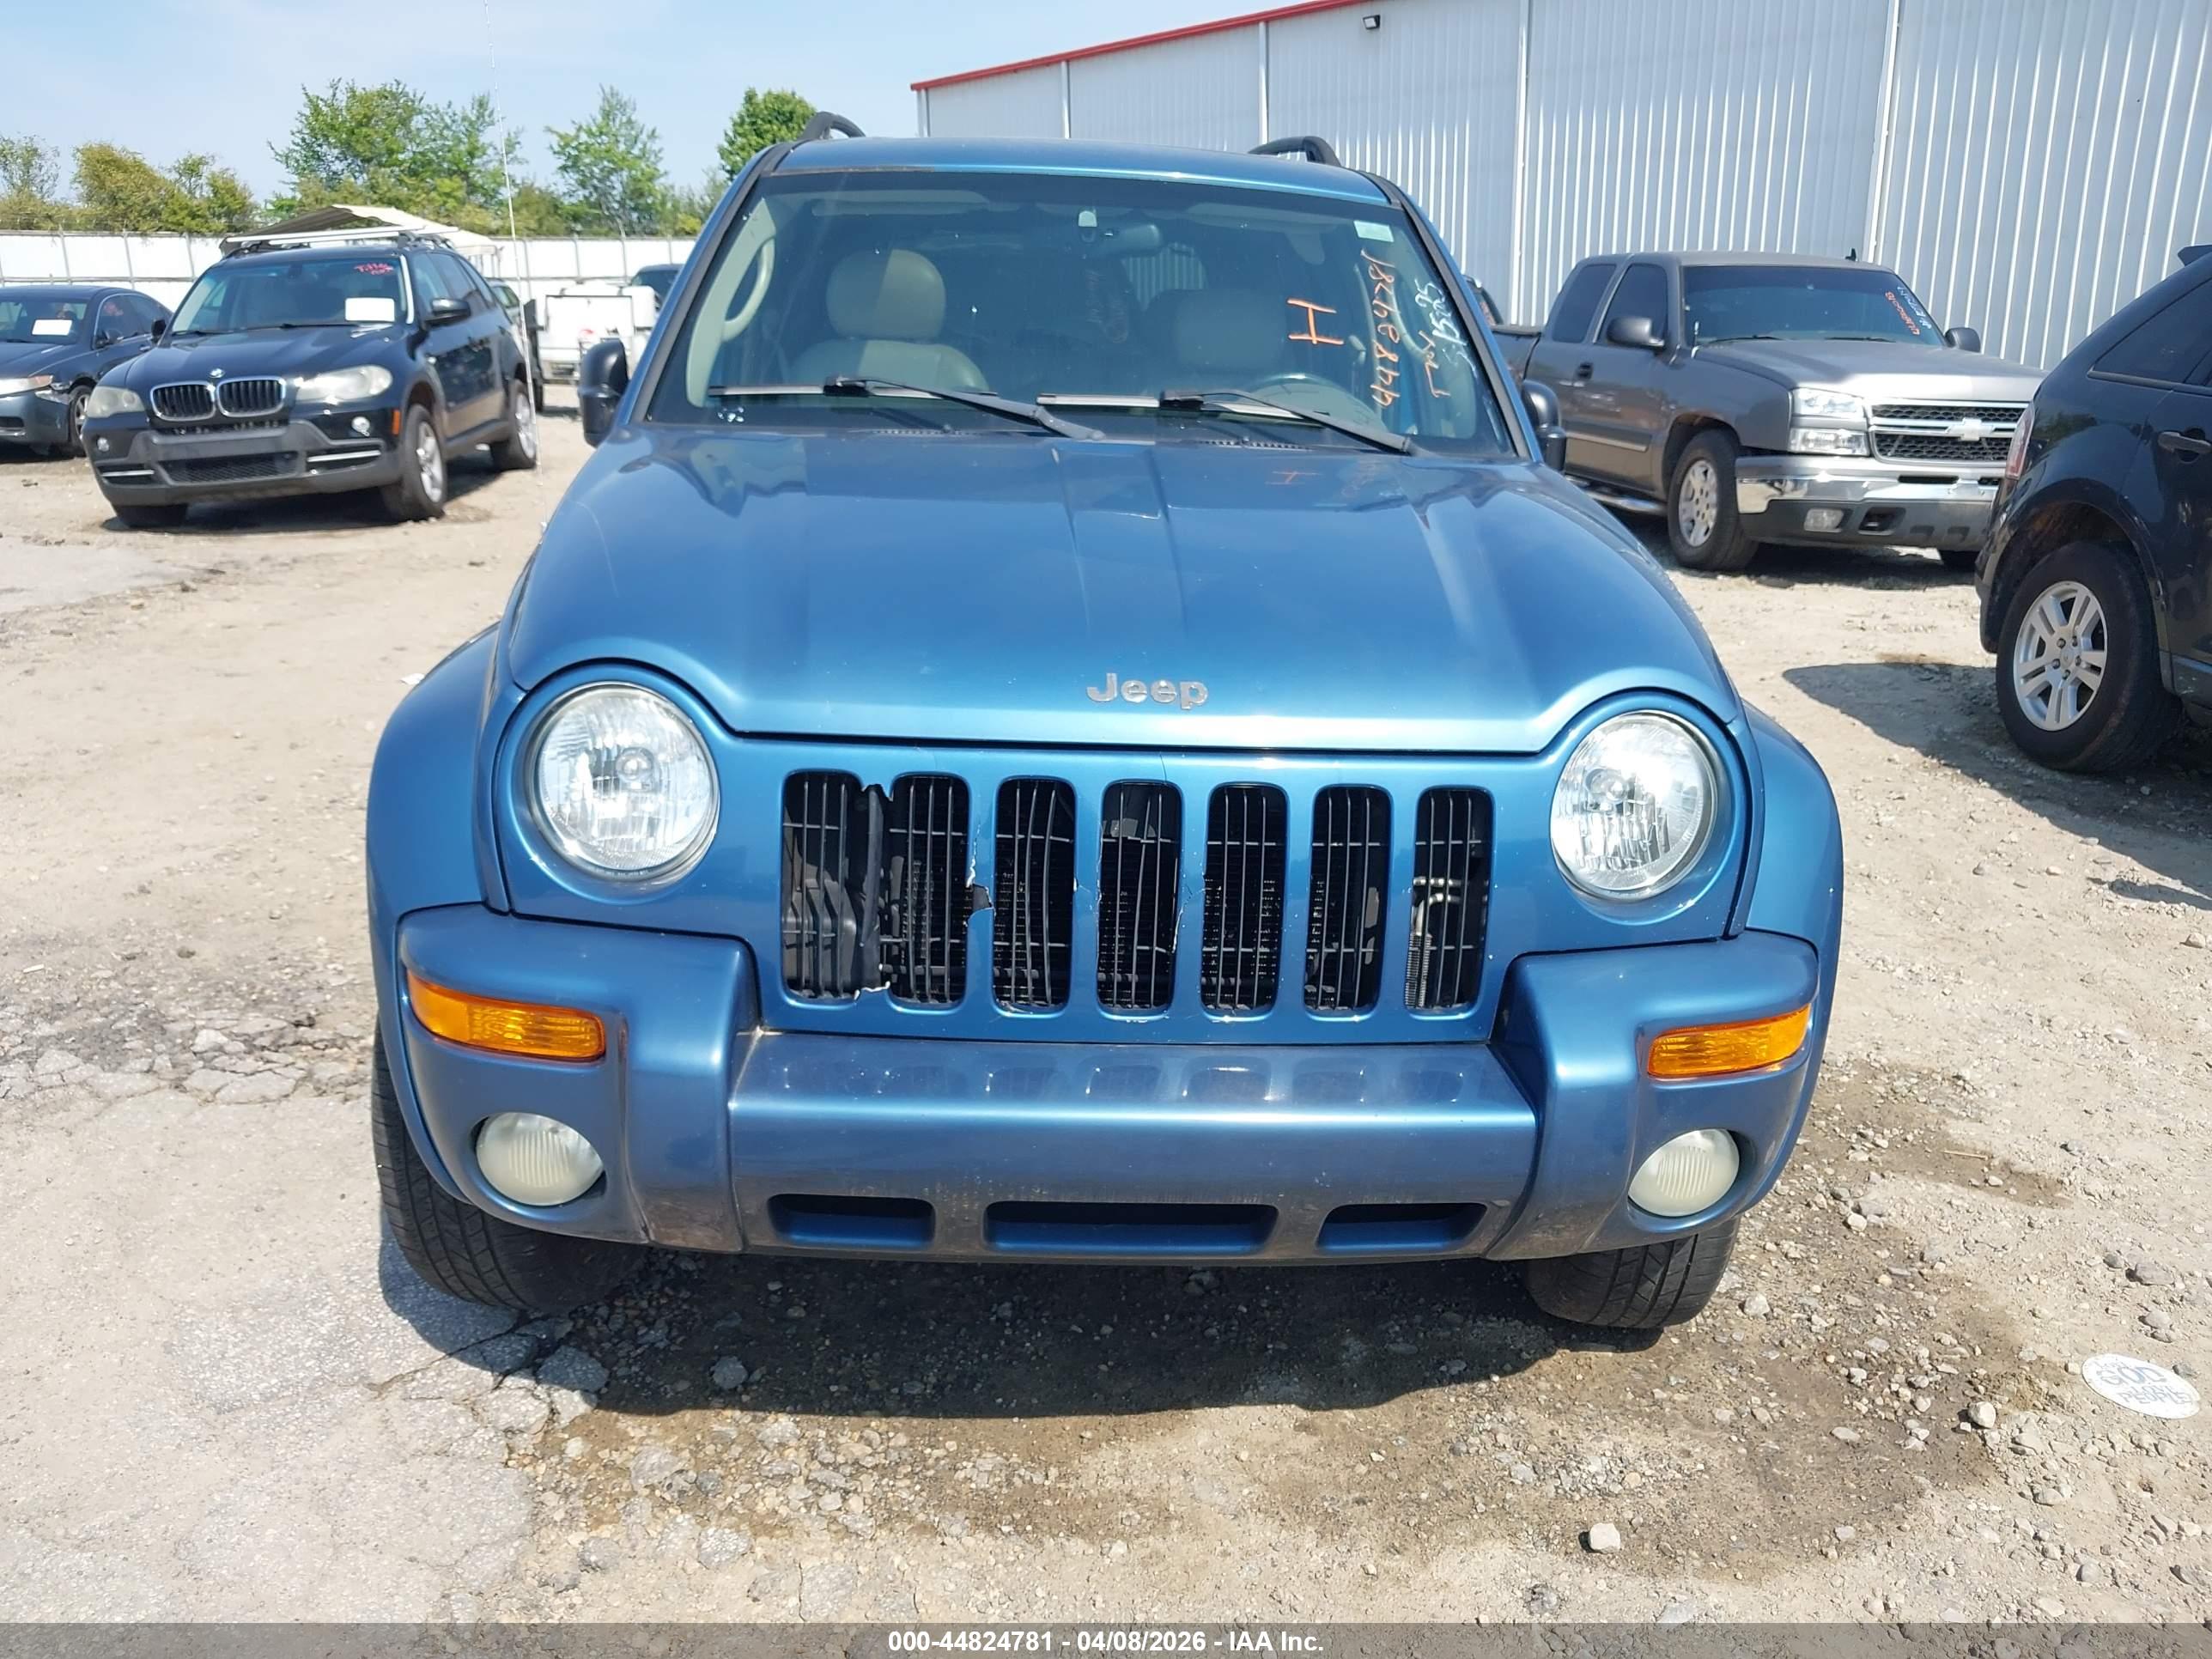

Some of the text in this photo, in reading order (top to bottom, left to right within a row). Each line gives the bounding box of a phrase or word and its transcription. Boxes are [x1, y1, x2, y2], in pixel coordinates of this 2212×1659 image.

[1287, 298, 1345, 345] H
[1361, 248, 1401, 408] 44824781
[1086, 672, 1209, 710] Jeep
